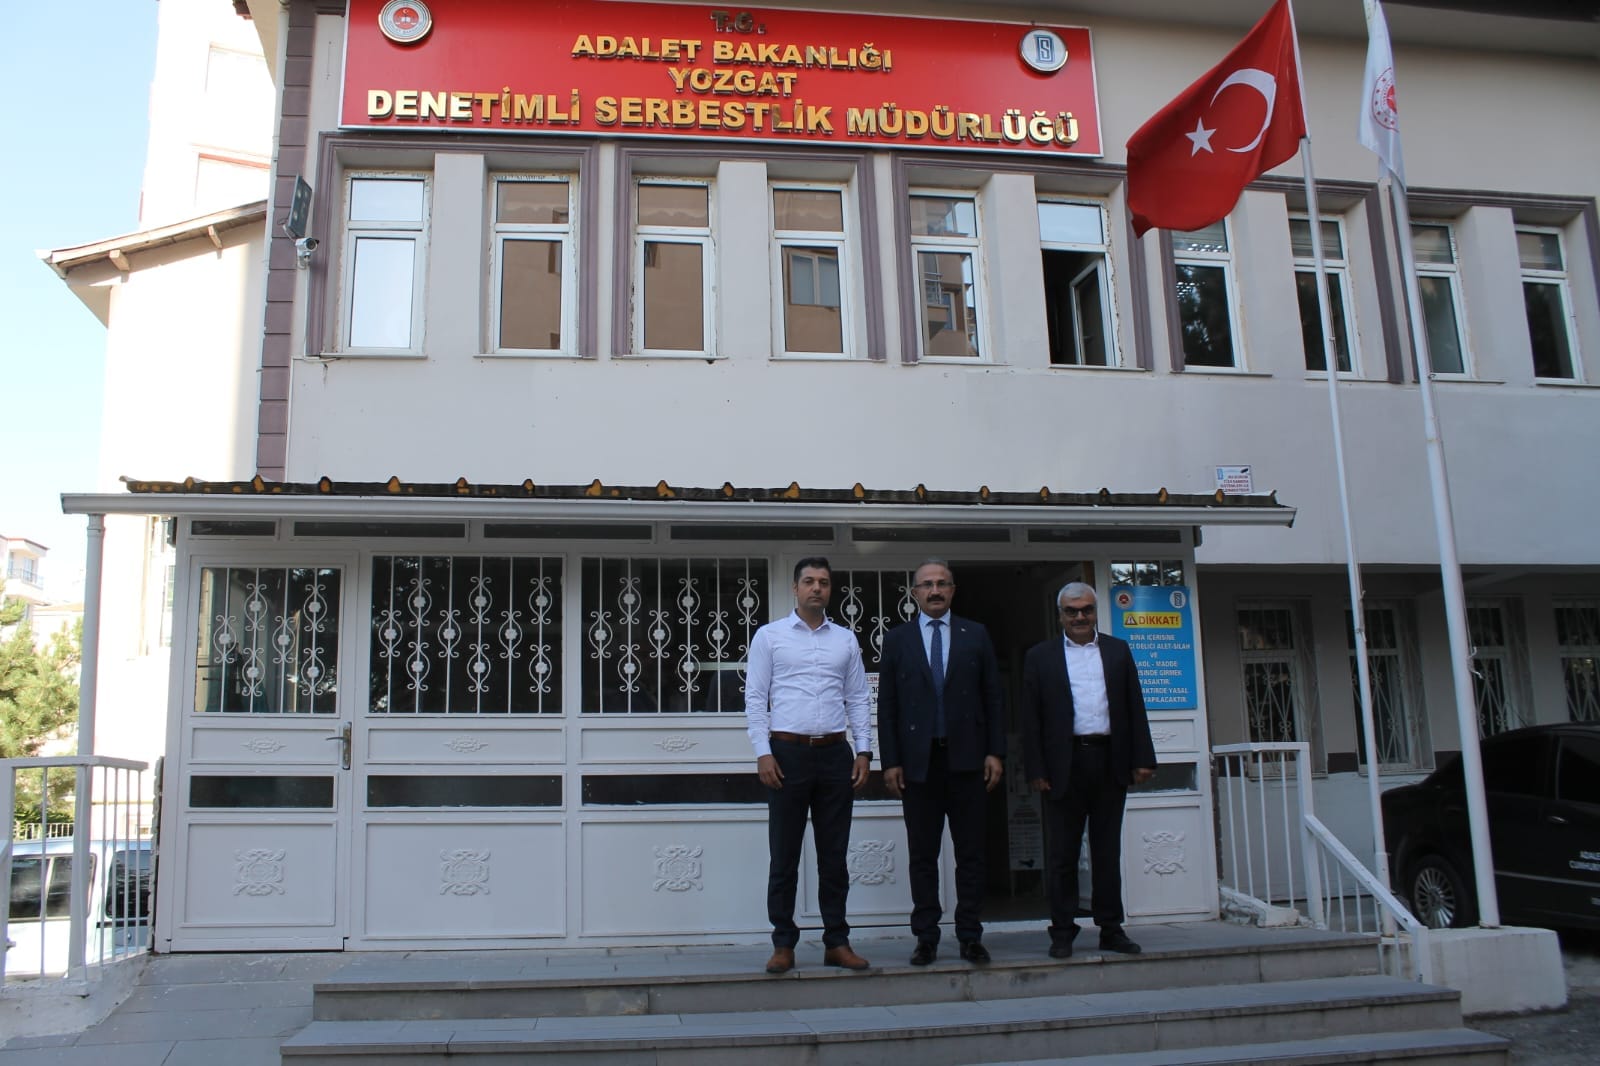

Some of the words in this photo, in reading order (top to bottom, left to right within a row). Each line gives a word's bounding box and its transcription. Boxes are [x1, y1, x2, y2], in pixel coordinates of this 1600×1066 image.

[571, 34, 702, 62] ADALET
[713, 39, 893, 72] BAKANLIĞI
[669, 66, 797, 97] YOZGAT
[367, 86, 581, 124] DENETİMLİ
[595, 96, 834, 133] SERBESTLİK
[846, 102, 1080, 147] MÜDÜRLÜĞÜ
